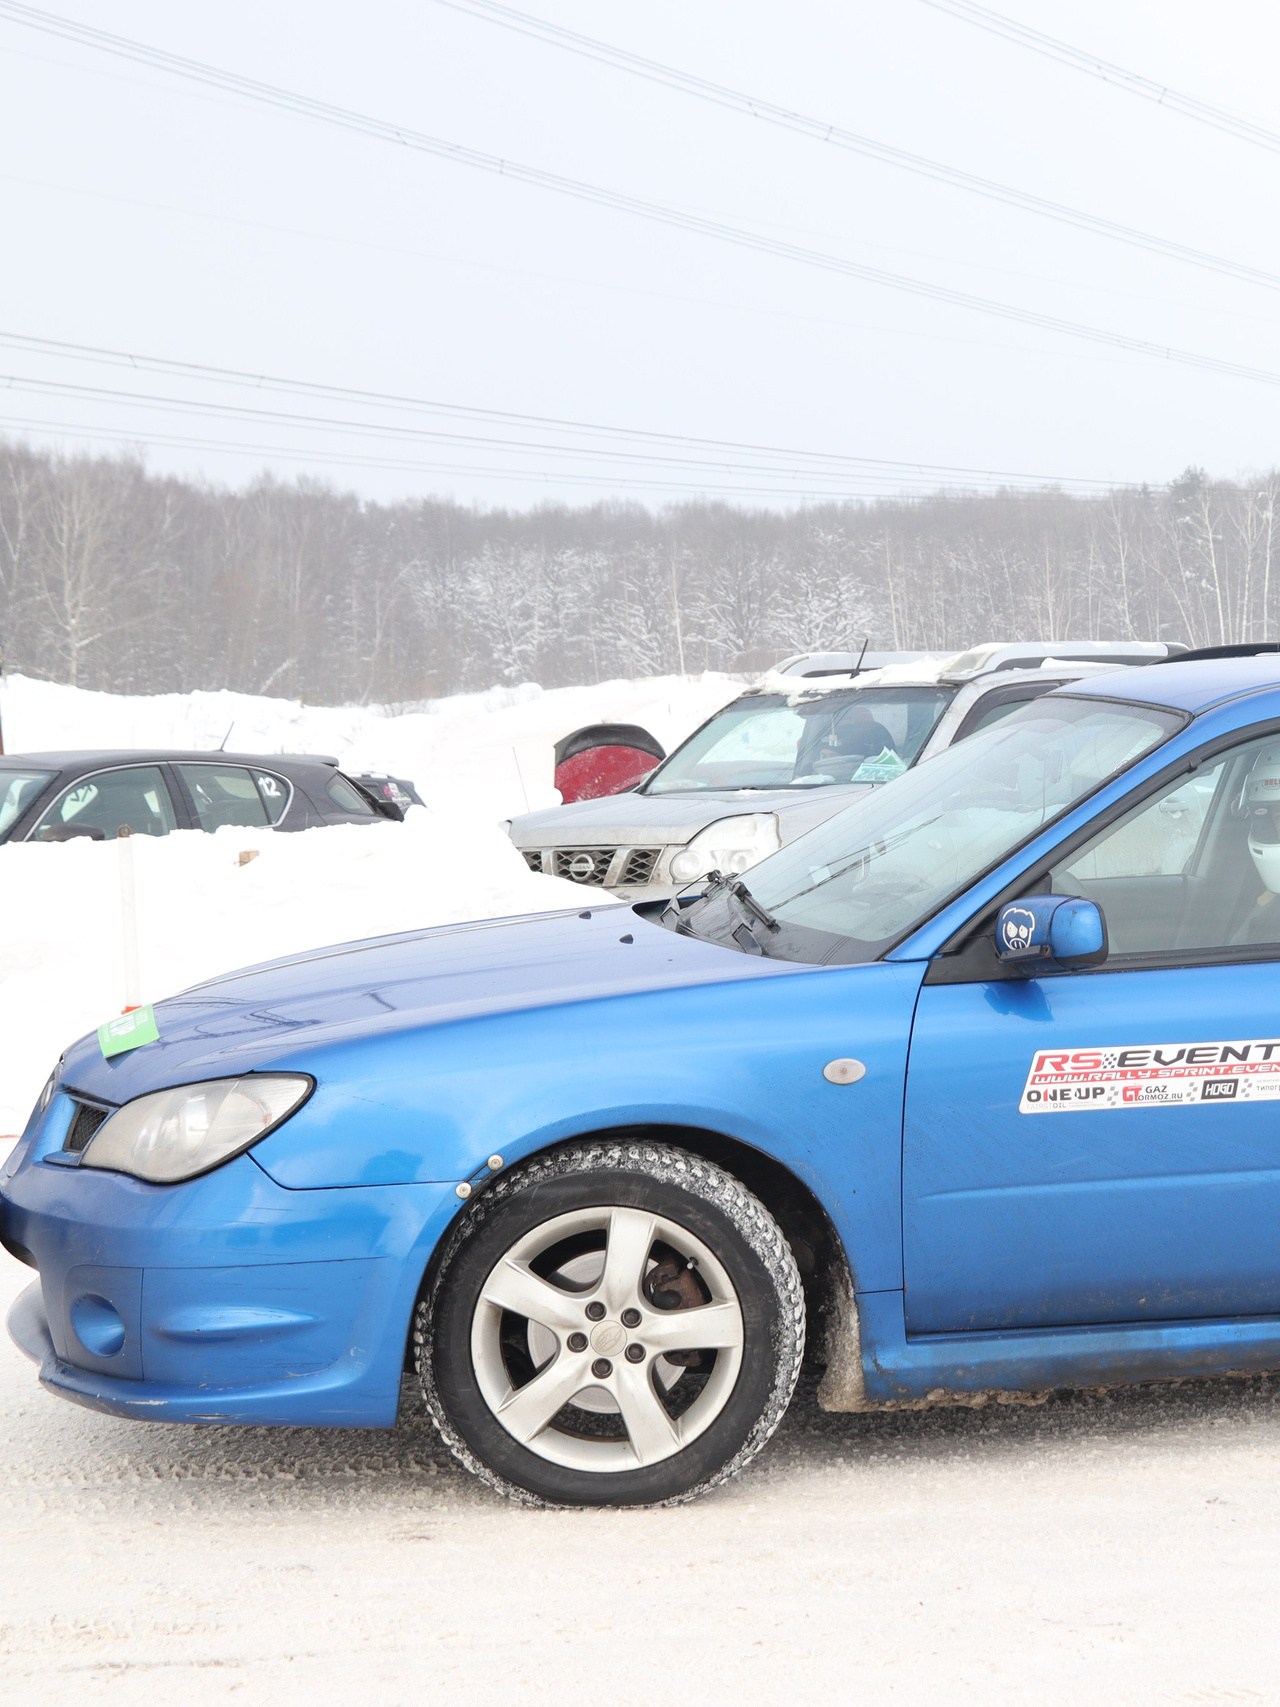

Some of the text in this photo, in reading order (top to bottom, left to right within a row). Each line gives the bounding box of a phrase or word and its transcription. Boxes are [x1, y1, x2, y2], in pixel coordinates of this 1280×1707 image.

[258, 776, 281, 796] 12
[1034, 1052, 1103, 1073] RS
[1074, 1086, 1106, 1100] UP
[1145, 1085, 1168, 1094] GAZ
